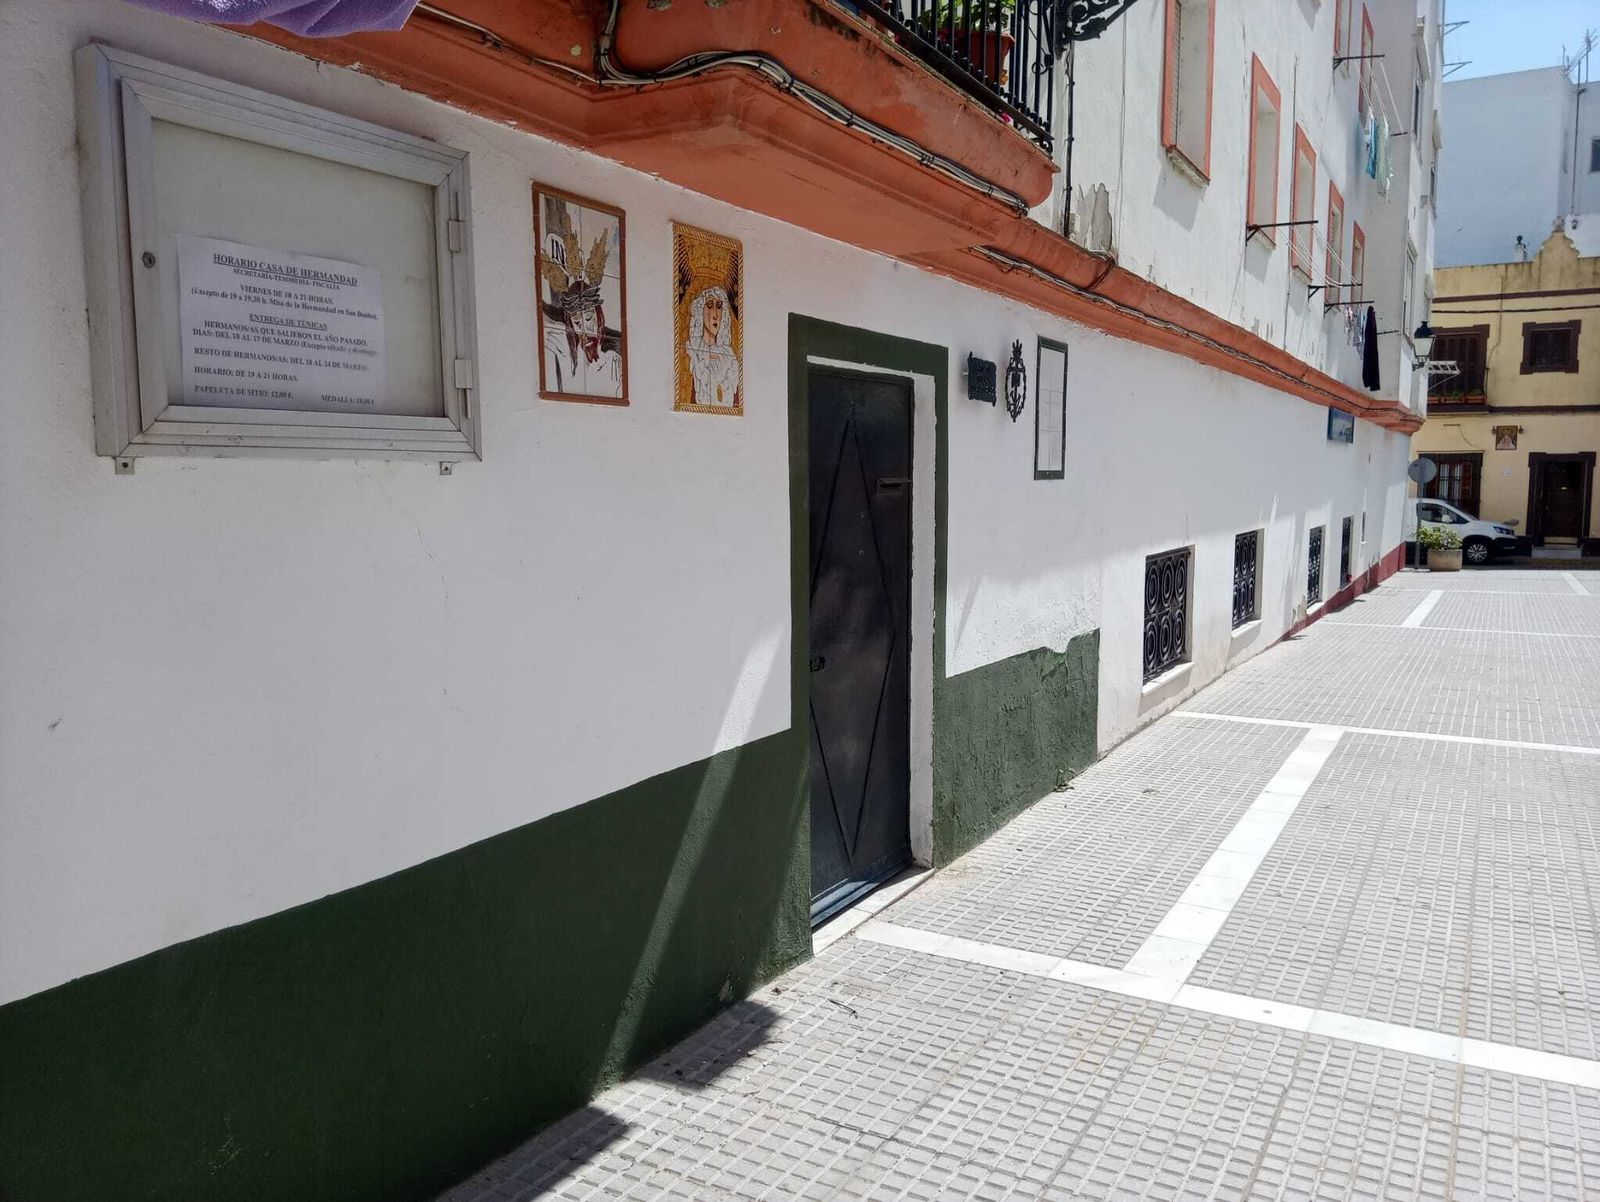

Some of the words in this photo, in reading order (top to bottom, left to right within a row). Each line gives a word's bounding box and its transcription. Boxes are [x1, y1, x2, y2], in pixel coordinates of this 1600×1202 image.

[213, 253, 257, 269] HORARIO
[259, 261, 283, 273] CASA
[286, 266, 298, 275] DE
[300, 268, 358, 285] HERMANDAD
[240, 284, 271, 295] VIERNES
[285, 300, 293, 308] de
[301, 303, 336, 314] Hermandad
[345, 308, 355, 316] San
[249, 313, 284, 324] ENTREGA
[286, 318, 295, 326] DE
[215, 331, 231, 339] DEL
[262, 336, 272, 344] DE
[273, 338, 299, 347] MARZO
[260, 327, 276, 336] QUE
[277, 329, 312, 341] SALIERON
[324, 334, 339, 343] AÑO
[194, 347, 220, 356] RESTO
[290, 357, 305, 365] DEL
[313, 359, 323, 367] AL
[194, 366, 233, 376] HORARIO:
[235, 369, 245, 377] DE
[194, 385, 234, 394] PAPELETA
[235, 388, 245, 396] DE
